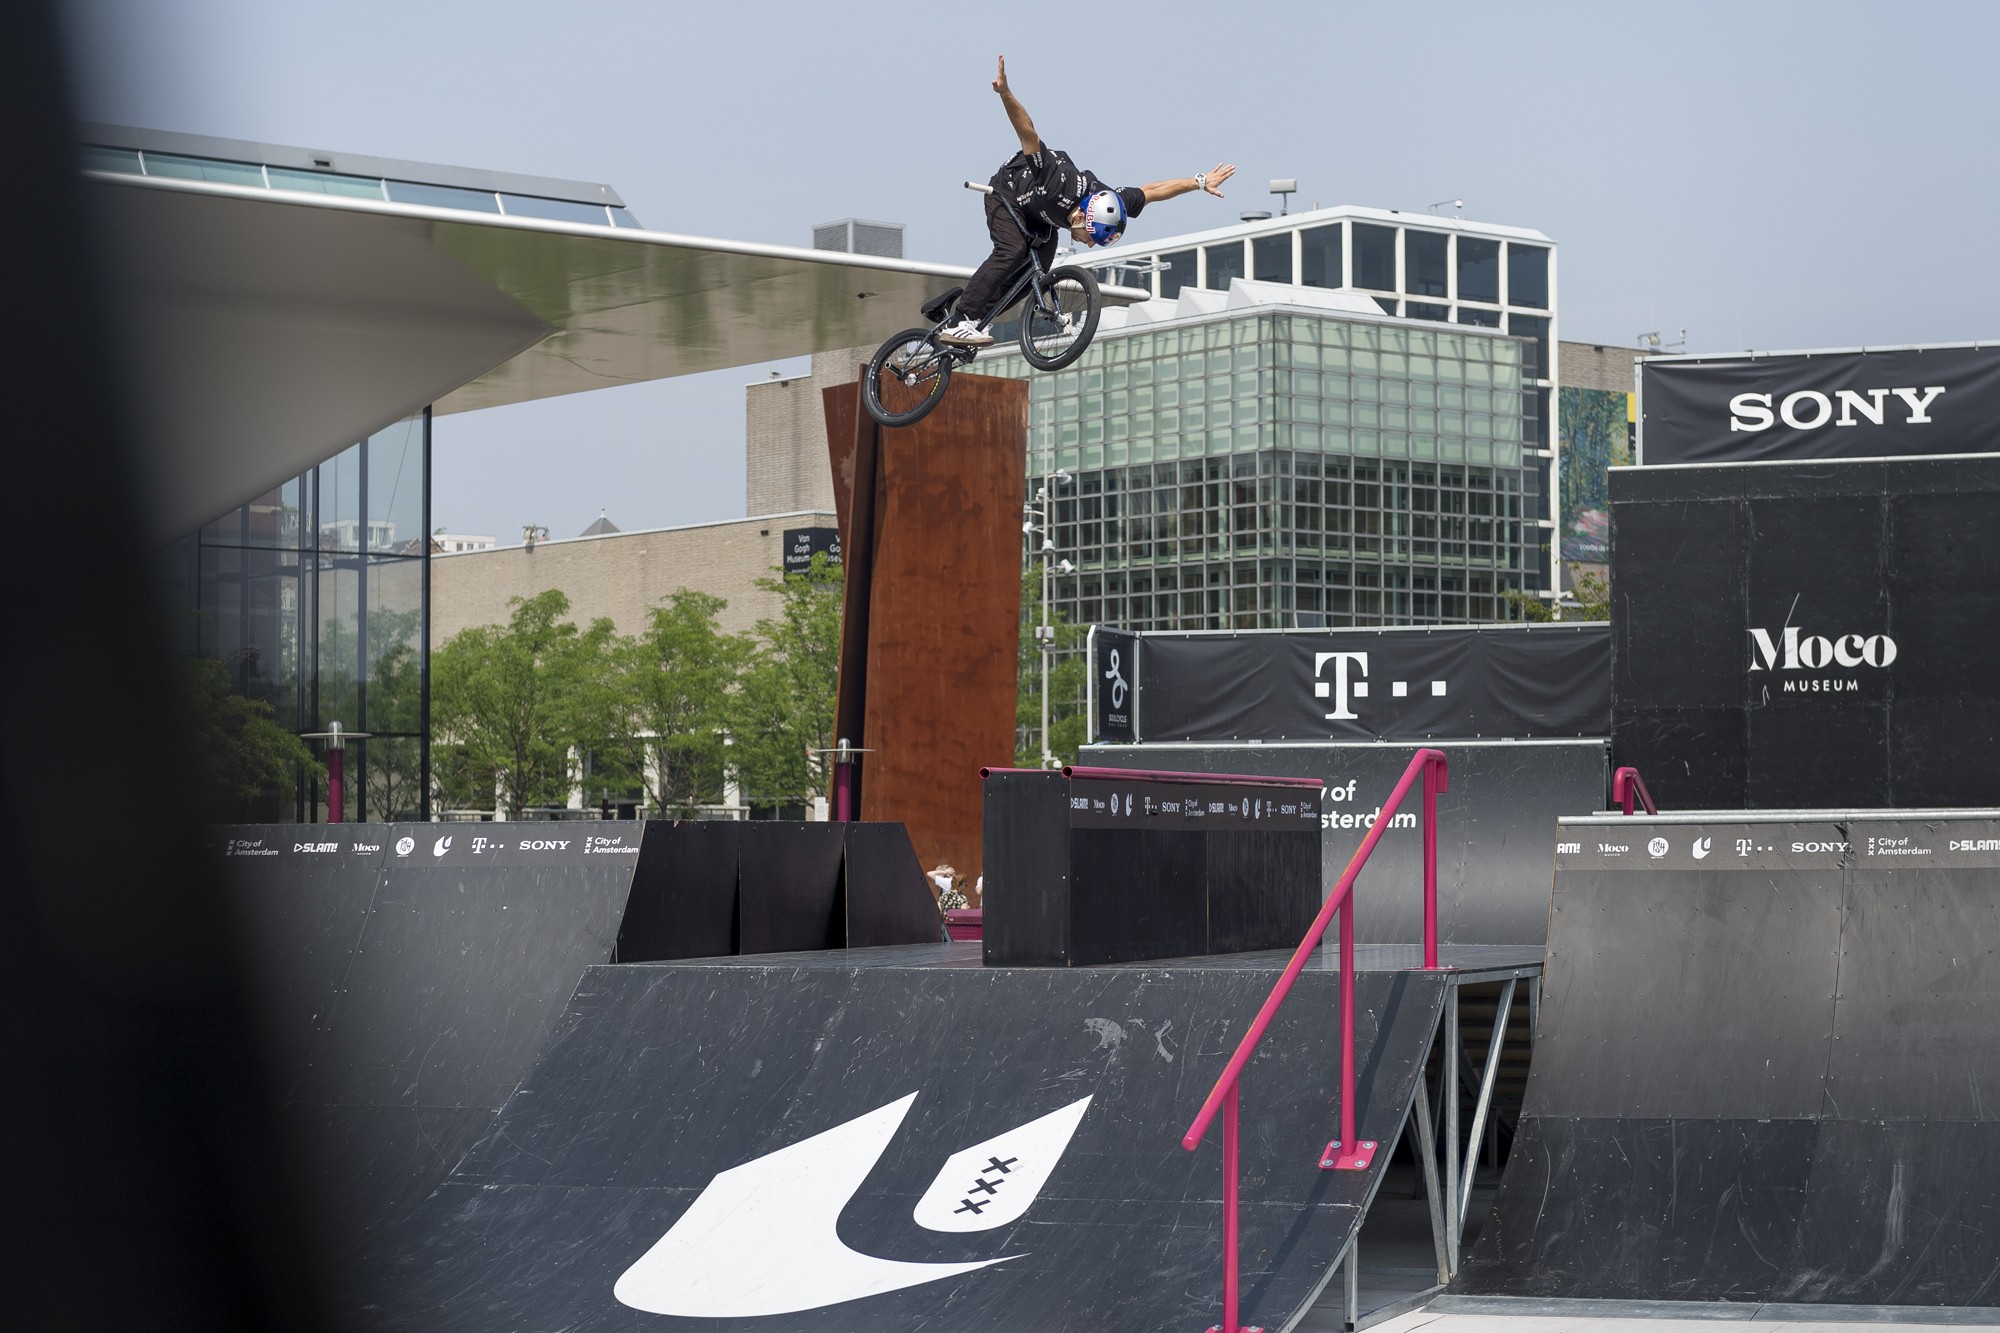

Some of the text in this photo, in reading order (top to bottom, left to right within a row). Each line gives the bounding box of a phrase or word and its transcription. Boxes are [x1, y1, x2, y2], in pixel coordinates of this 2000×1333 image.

[1085, 194, 1100, 234] Red Bull
[1729, 386, 1946, 432] SONY
[798, 534, 810, 543] Van
[794, 543, 810, 553] Gogh
[829, 543, 841, 553] Go
[786, 555, 810, 564] Museum
[1745, 627, 1897, 672] Moco
[1783, 679, 1859, 692] MUSEUM
[1330, 779, 1357, 802] of
[1162, 801, 1181, 813] SONY
[1280, 804, 1297, 815] SONY
[1321, 806, 1417, 829] sterdm
[236, 839, 262, 849] City of
[519, 840, 571, 851] SONY
[594, 836, 622, 847] City of
[1878, 837, 1909, 848] City of
[234, 848, 279, 856] Amsterdam
[302, 842, 339, 853] SLAM!
[351, 843, 380, 852] Moco
[592, 845, 639, 854] Amsterdam
[1556, 842, 1581, 854] AM!
[1598, 843, 1629, 853] Moco
[1791, 842, 1849, 853] SONY
[1877, 847, 1932, 855] Amsterdam
